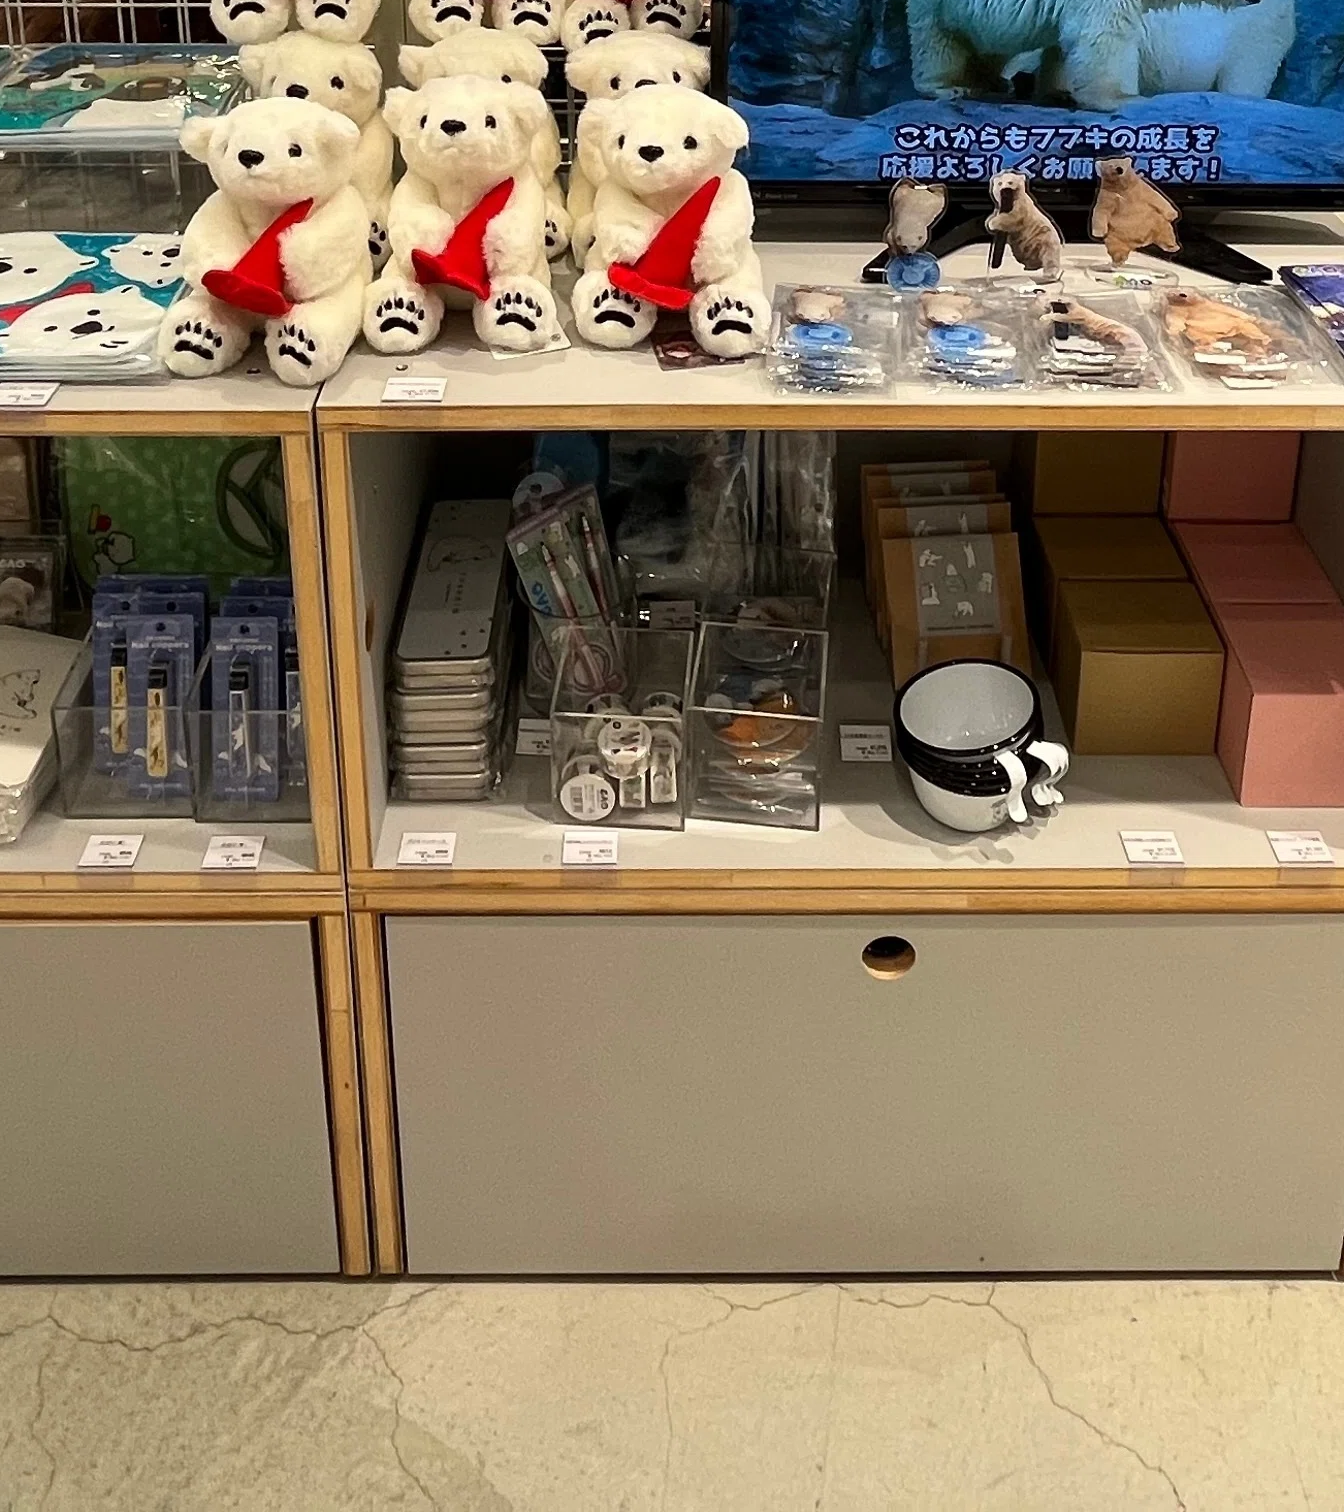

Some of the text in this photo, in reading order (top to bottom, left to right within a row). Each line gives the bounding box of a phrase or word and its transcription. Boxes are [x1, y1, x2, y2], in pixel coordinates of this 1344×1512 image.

[896, 125, 1217, 152] これからもフブキの成長を
